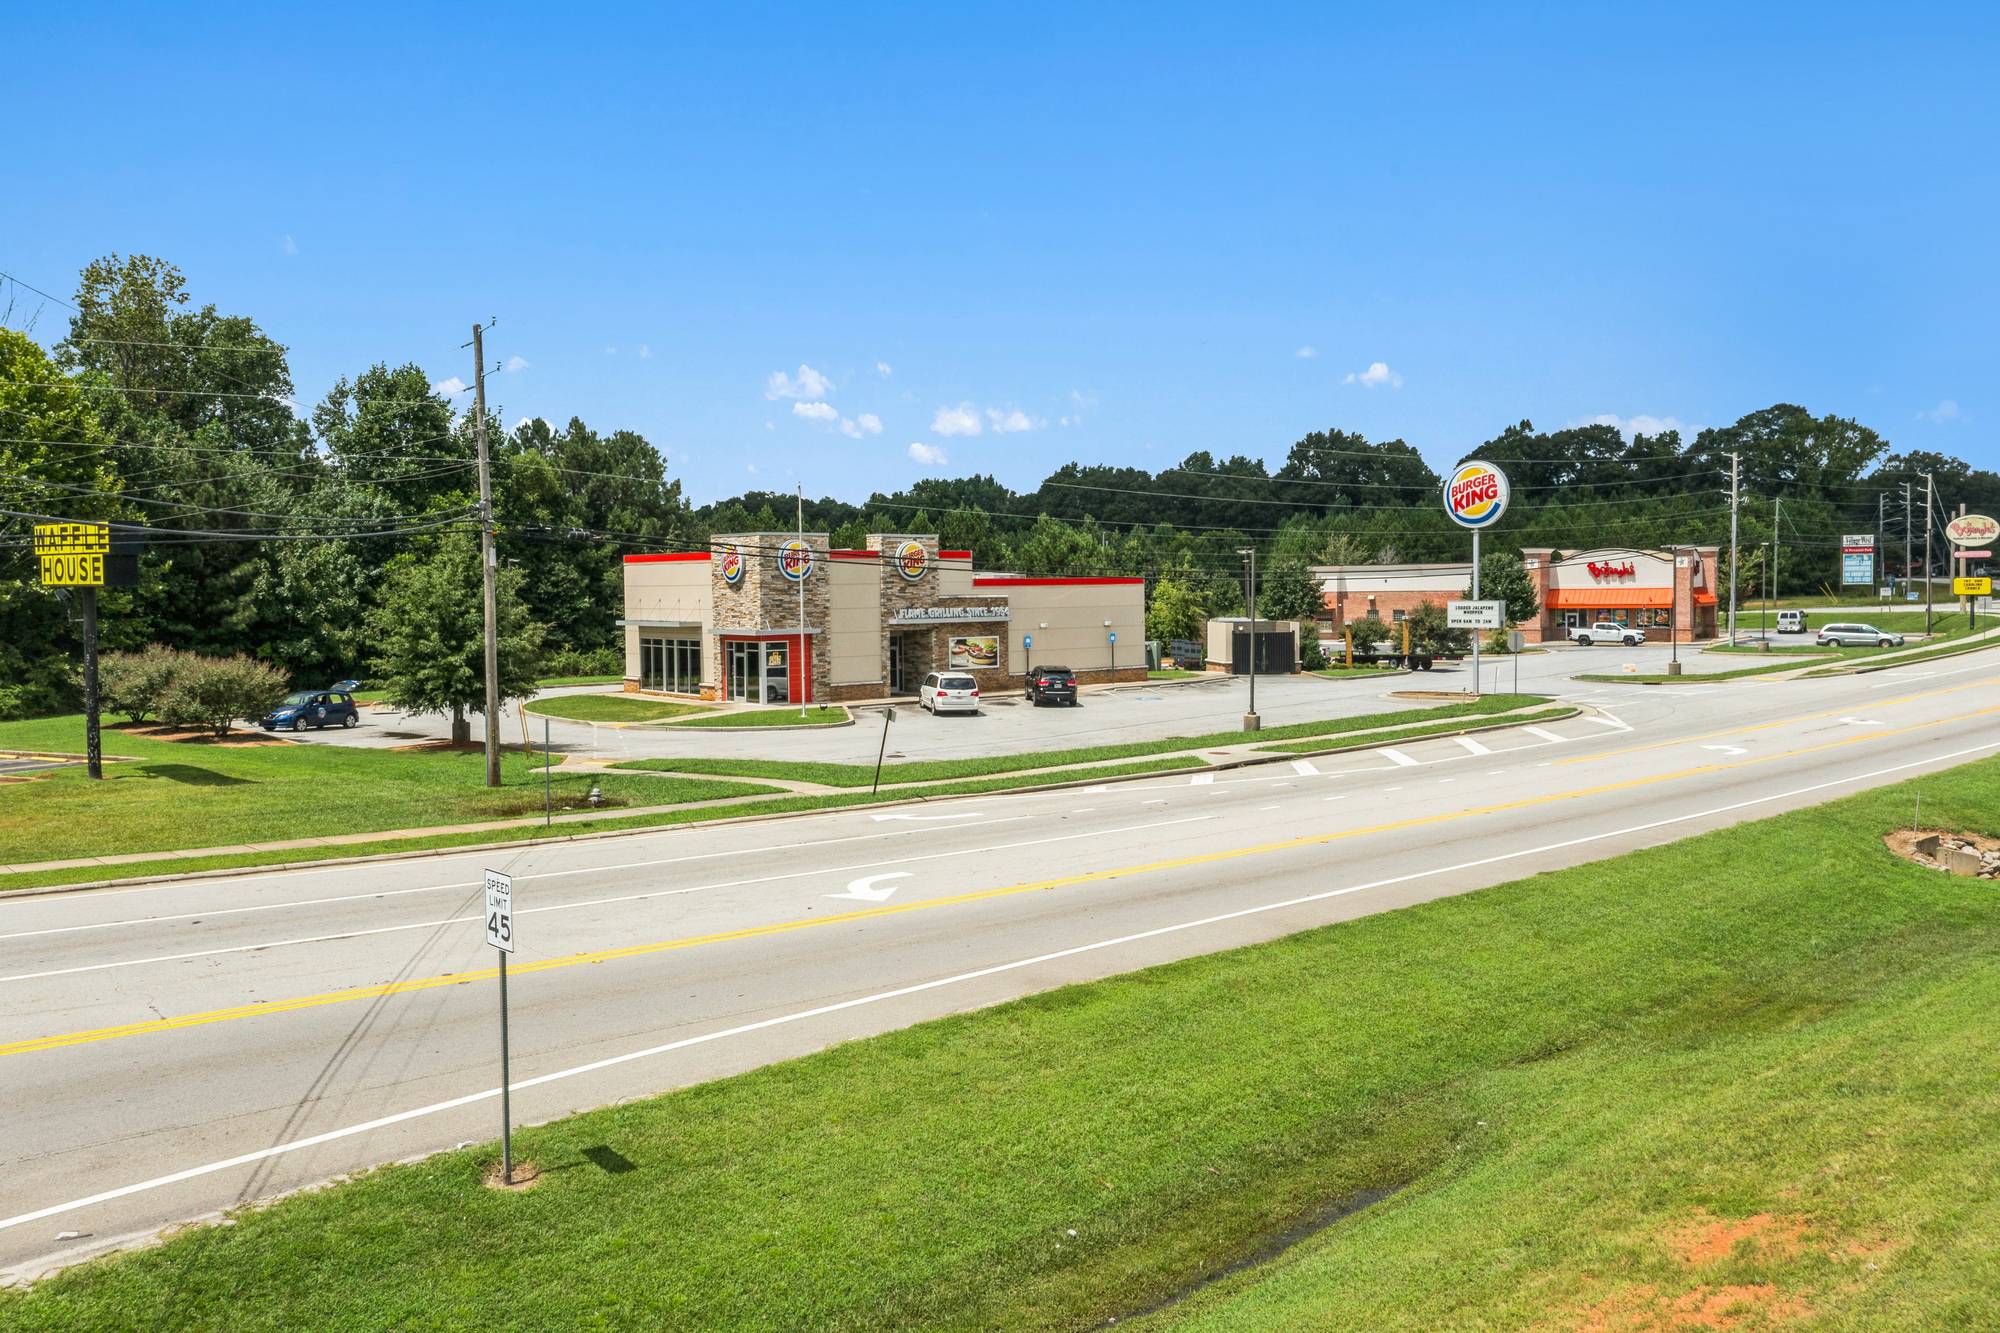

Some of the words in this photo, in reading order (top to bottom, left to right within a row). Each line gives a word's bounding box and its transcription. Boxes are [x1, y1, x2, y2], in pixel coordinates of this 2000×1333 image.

[1451, 473, 1496, 498] BURGER
[1453, 484, 1498, 513] KING
[35, 525, 108, 551] WAFFLE
[42, 557, 102, 582] HOUSE
[723, 556, 739, 572] KING
[487, 879, 509, 895] SPEED
[489, 895, 507, 910] LIMIT
[488, 912, 511, 942] 45
